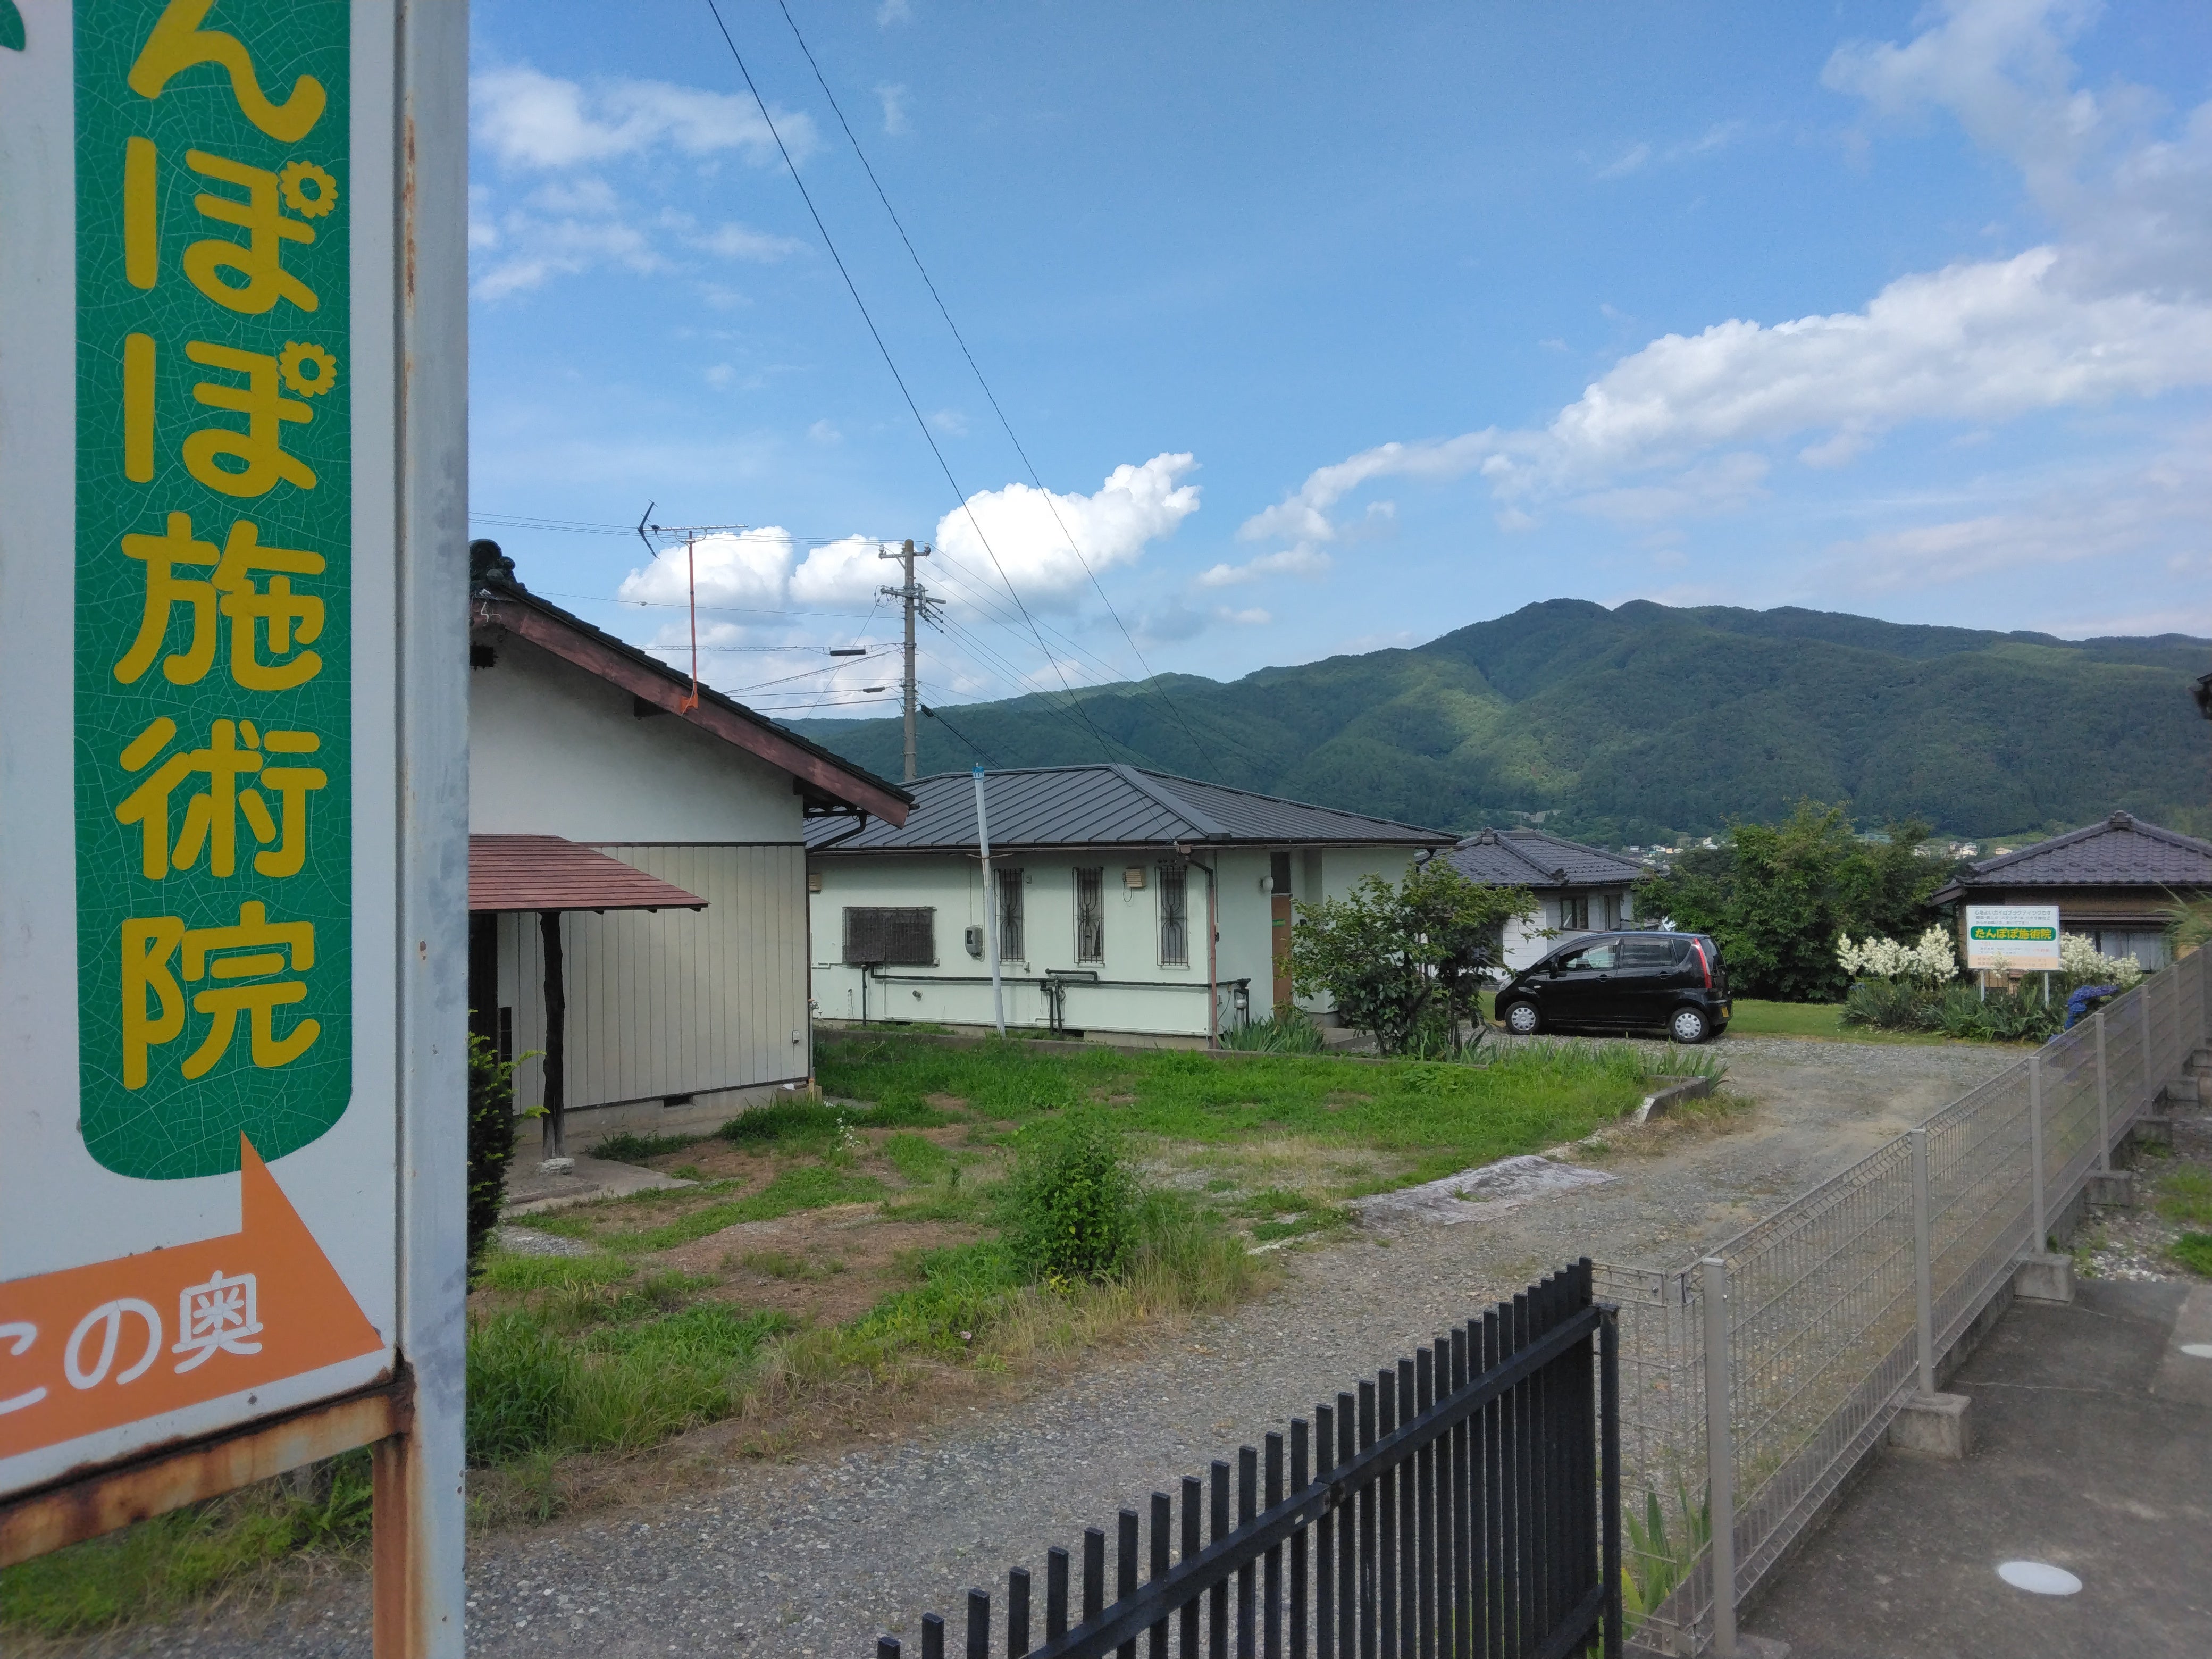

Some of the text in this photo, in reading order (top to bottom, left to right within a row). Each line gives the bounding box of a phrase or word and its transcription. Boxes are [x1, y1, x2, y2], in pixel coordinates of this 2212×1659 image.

[1975, 928, 2052, 939] たんぽぽ施術院
